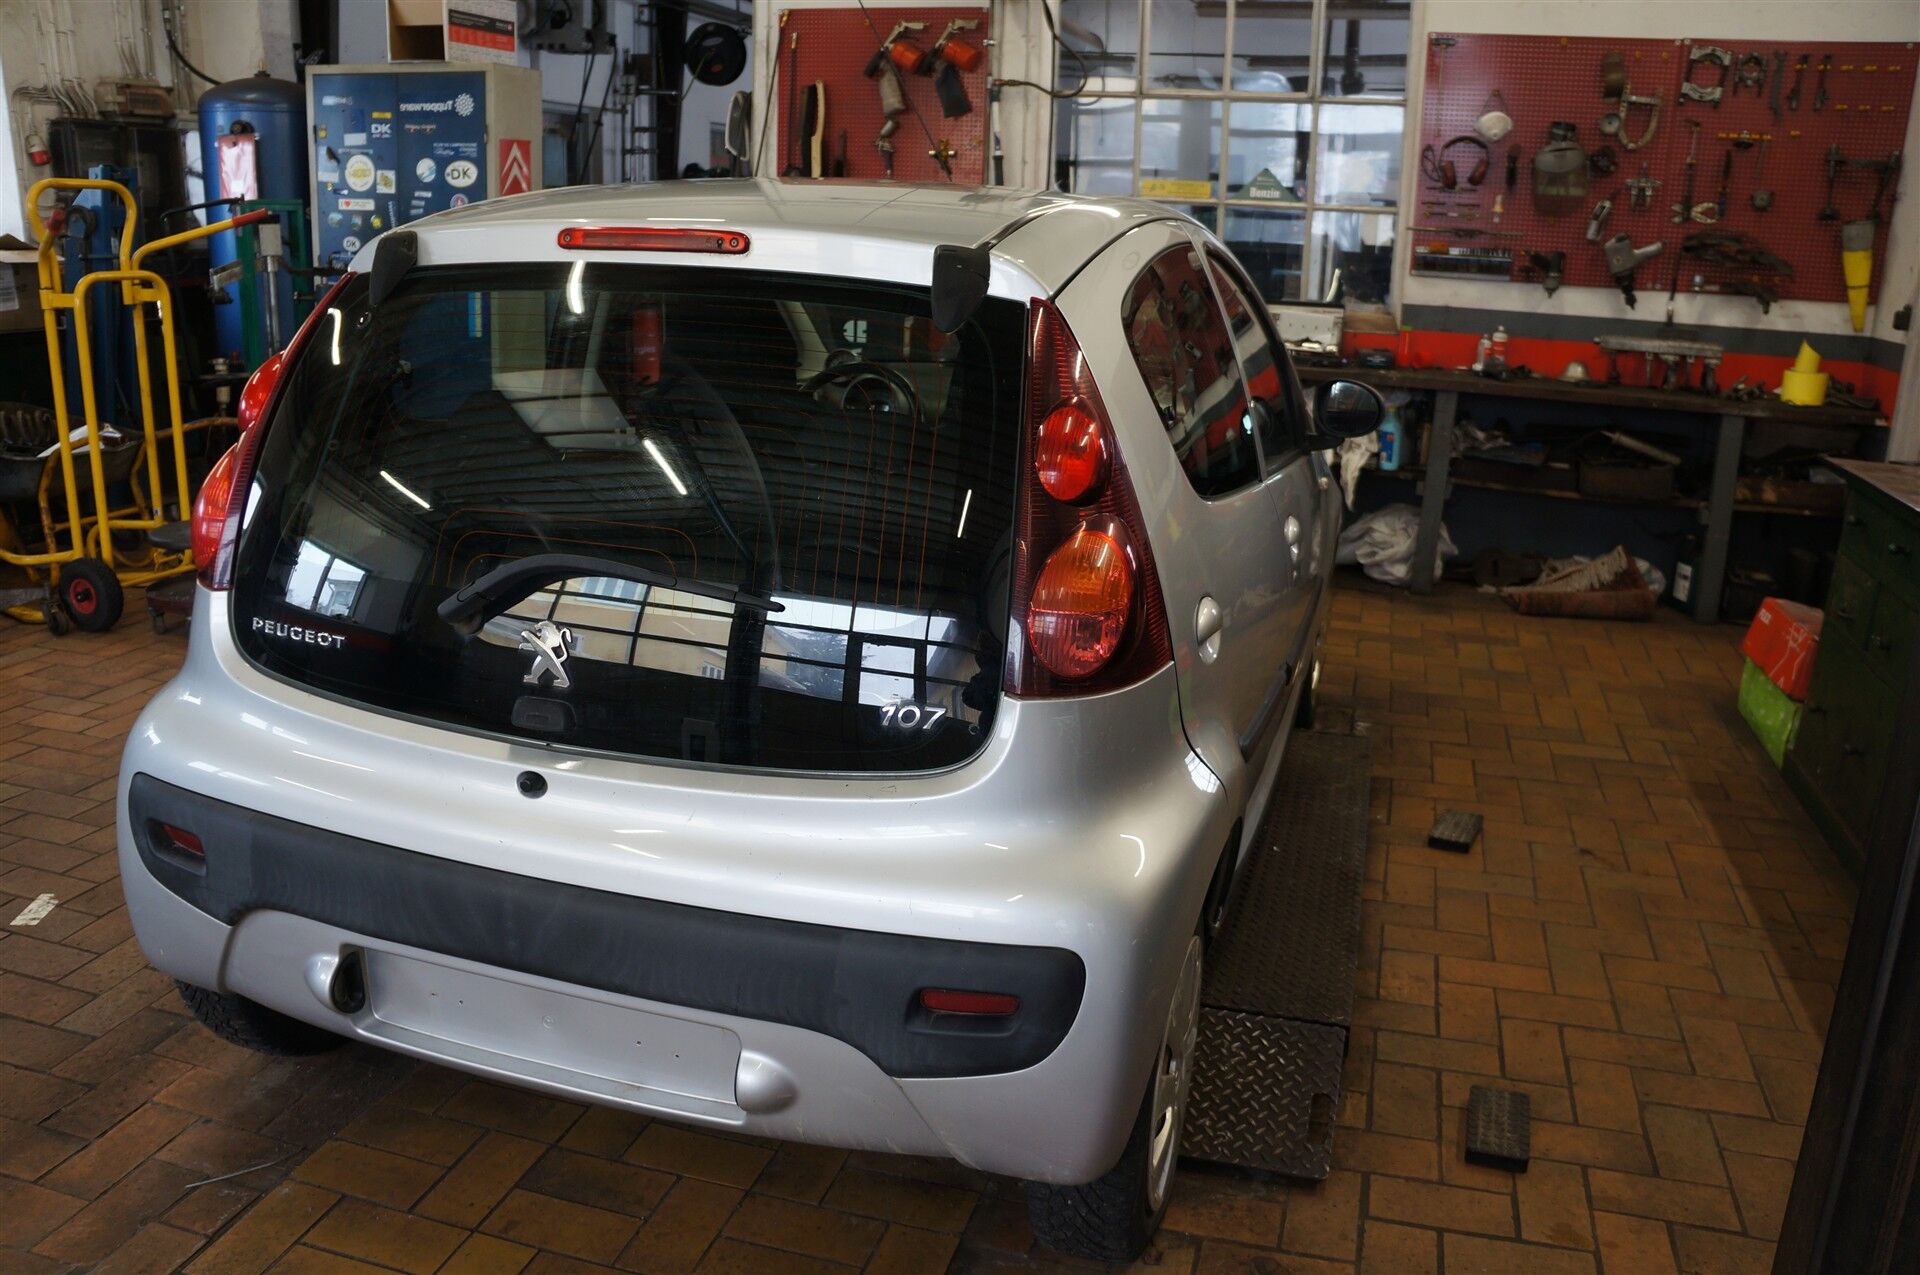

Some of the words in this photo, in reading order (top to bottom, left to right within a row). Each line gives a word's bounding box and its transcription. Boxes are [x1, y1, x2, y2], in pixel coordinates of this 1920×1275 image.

[370, 123, 392, 134] DK
[450, 168, 471, 180] DK
[1249, 187, 1281, 198] Benzin
[345, 240, 357, 249] DK
[252, 617, 345, 649] PEUGEOT
[882, 705, 947, 729] 107
